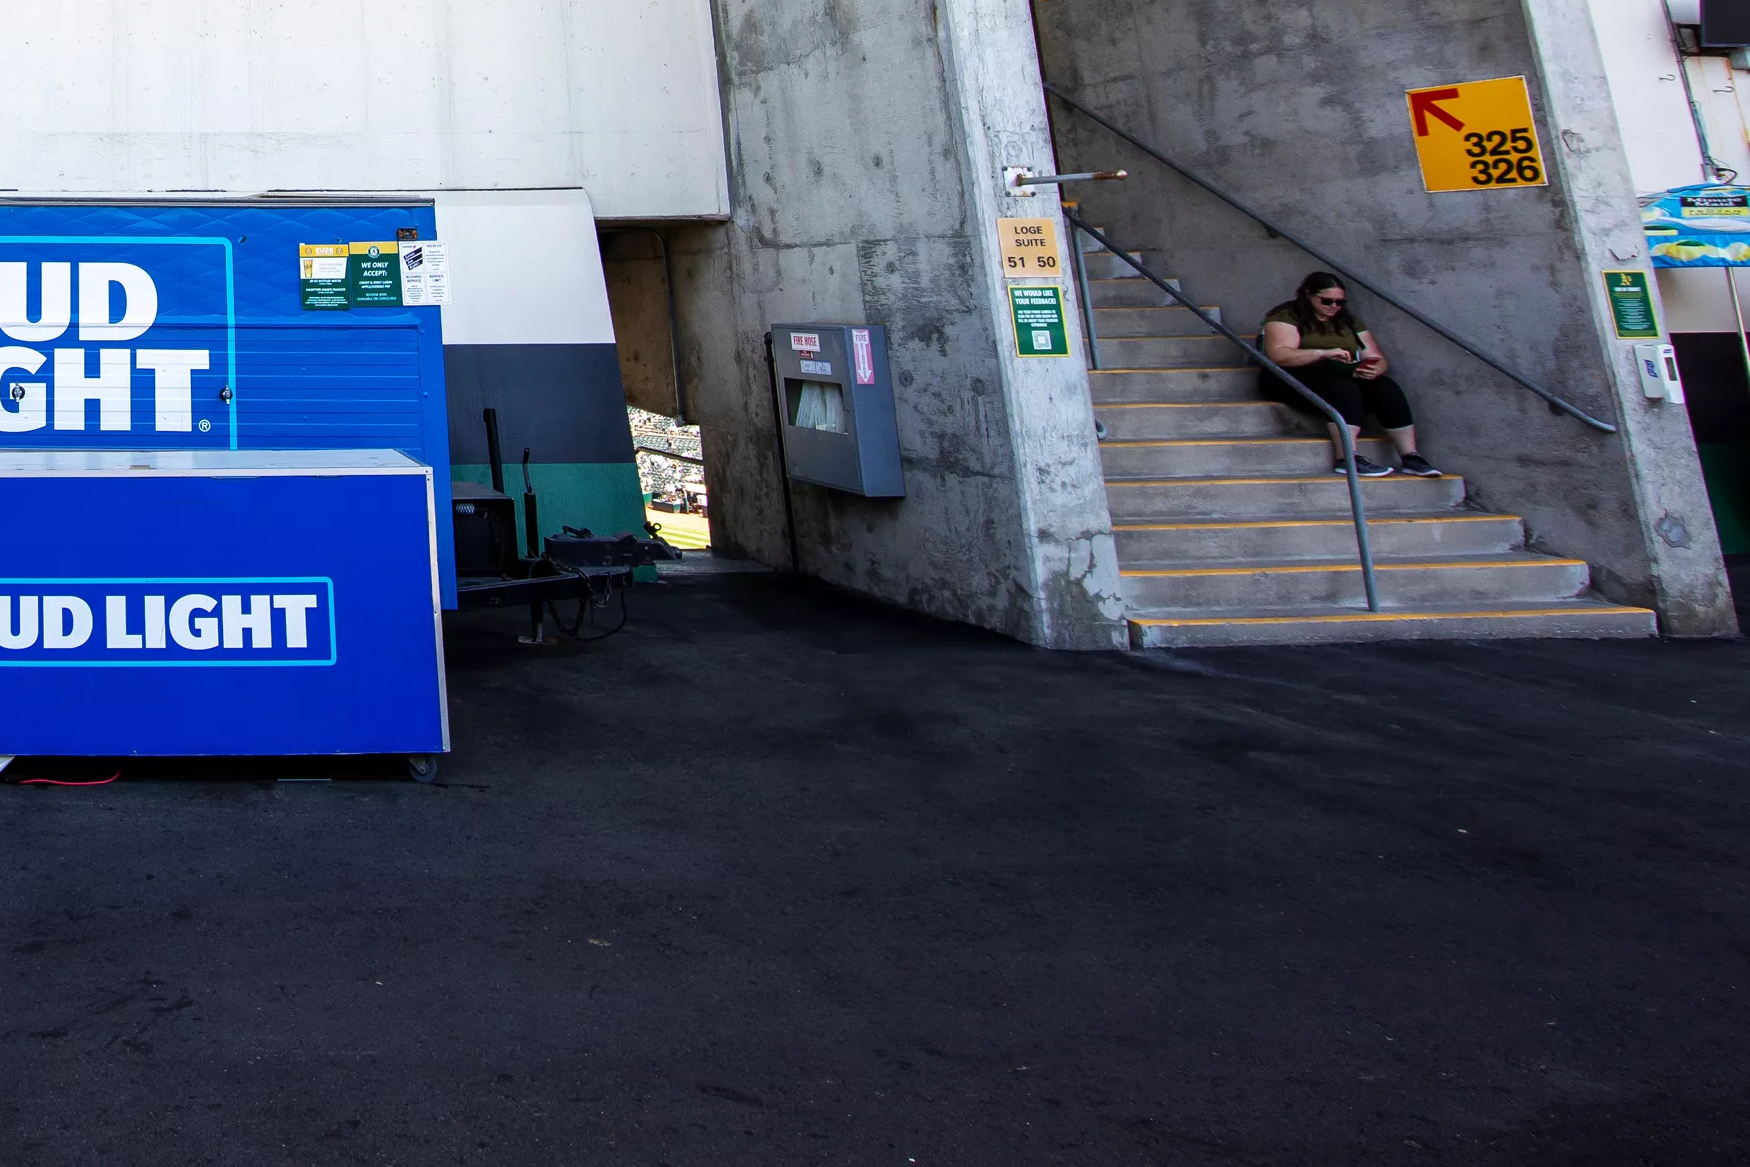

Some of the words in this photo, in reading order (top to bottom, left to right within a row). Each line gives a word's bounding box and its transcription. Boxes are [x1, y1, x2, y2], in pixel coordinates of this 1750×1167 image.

[1463, 127, 1534, 158] 325
[1470, 155, 1540, 185] 326
[1014, 226, 1043, 235] LOGE
[1015, 238, 1046, 247] SUITE
[1007, 256, 1025, 268] 51
[1037, 256, 1056, 268] 50
[793, 335, 804, 345] FIRE
[804, 336, 818, 347] HOSE
[855, 334, 867, 342] FIRE
[106, 593, 317, 650] LIGHT
